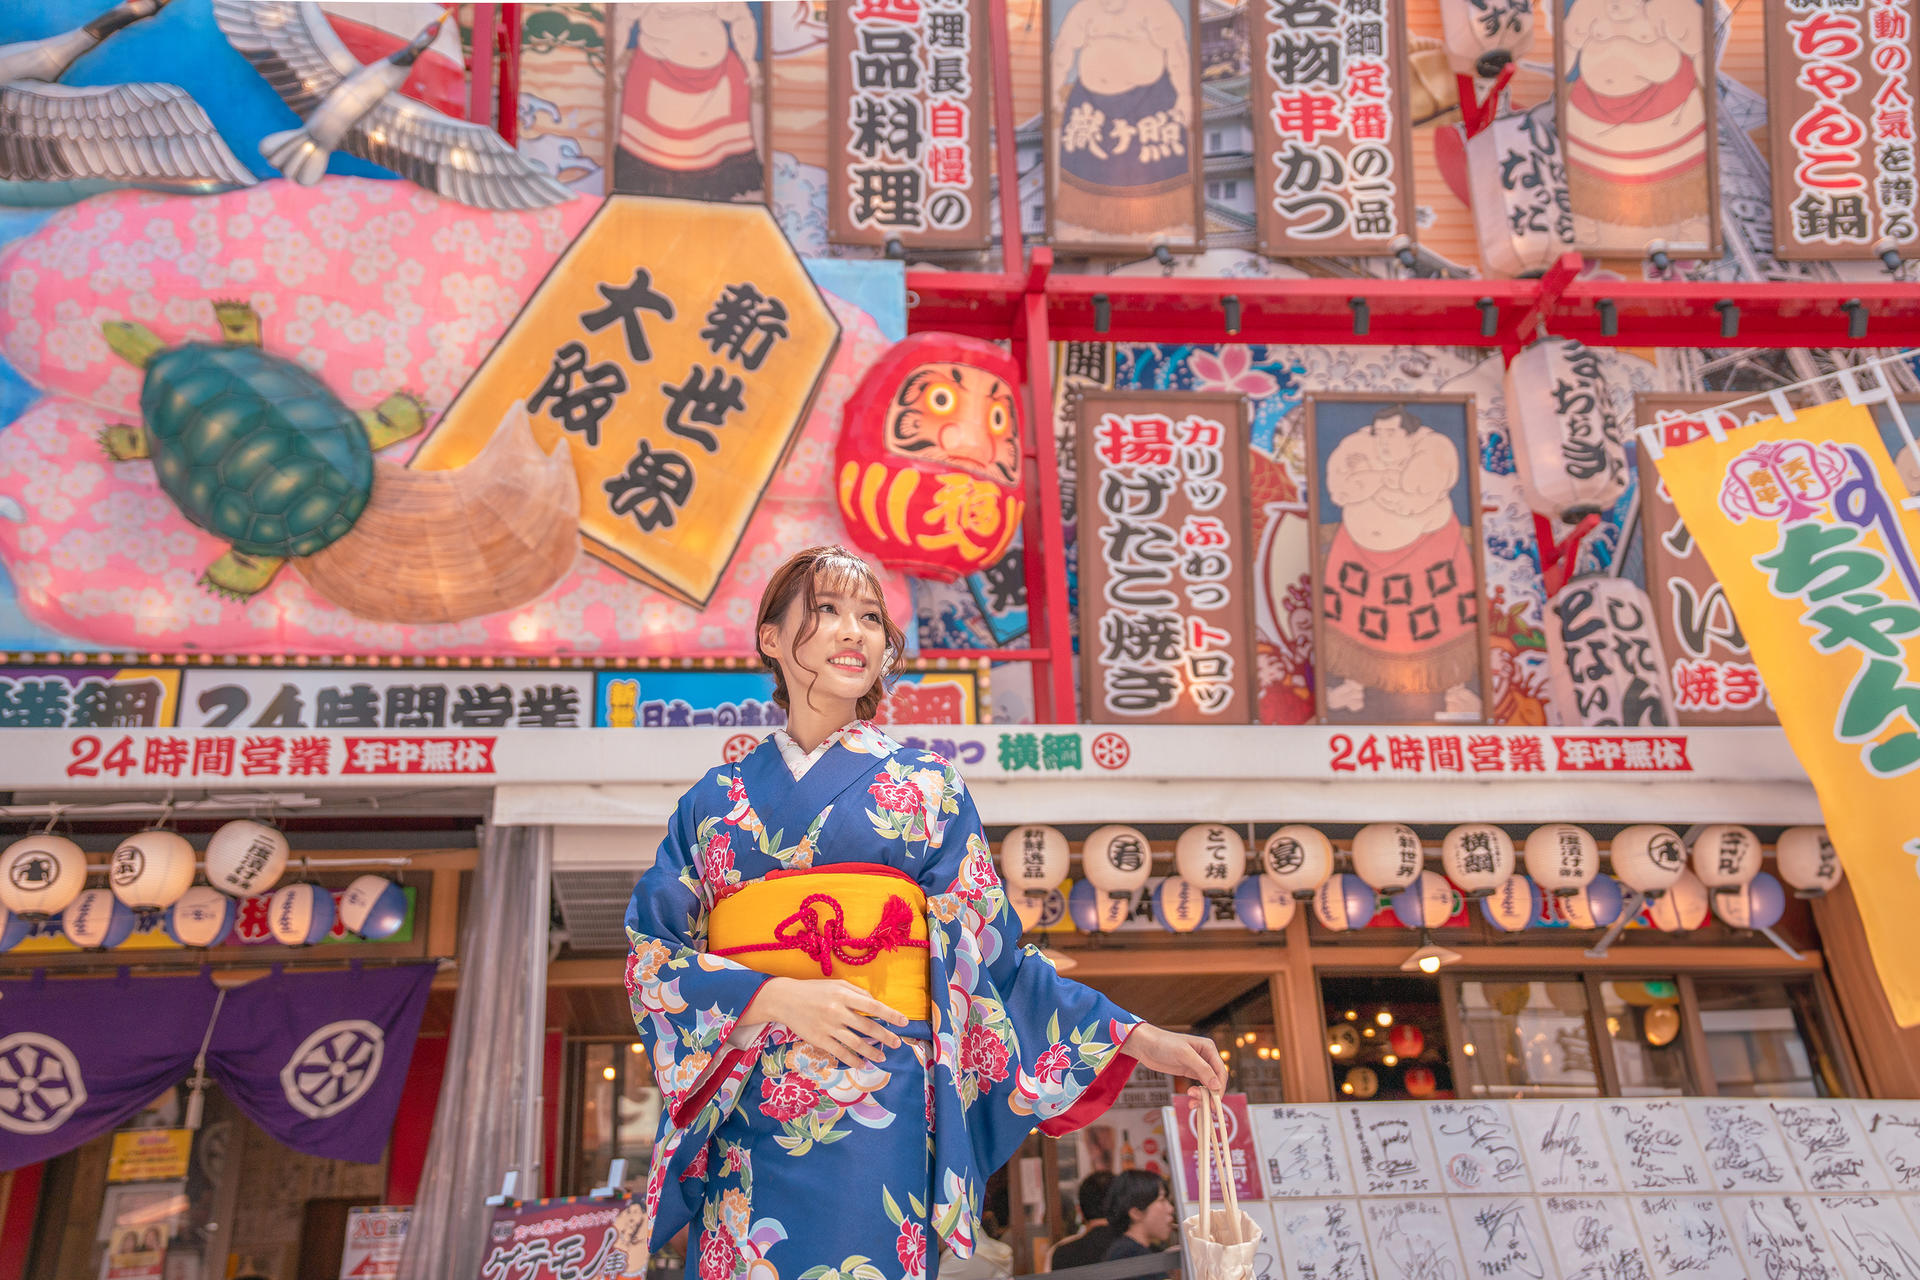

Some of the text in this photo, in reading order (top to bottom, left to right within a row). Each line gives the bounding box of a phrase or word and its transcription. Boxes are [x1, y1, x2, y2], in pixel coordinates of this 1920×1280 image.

[927, 0, 967, 225] 理長自慢の
[1792, 13, 1868, 238] ちゃんこ鍋
[1873, 0, 1912, 239] 動の人気を誇る
[527, 268, 675, 447] 大阪
[604, 283, 789, 532] 新世界
[1102, 418, 1184, 709] 揚げたこ焼き
[66, 735, 331, 777] 24時間営業
[351, 740, 489, 772] 年中無休
[901, 732, 1083, 771] かつ 横綱
[1329, 733, 1546, 773] 24時間営業
[1562, 738, 1684, 769] 年中無休
